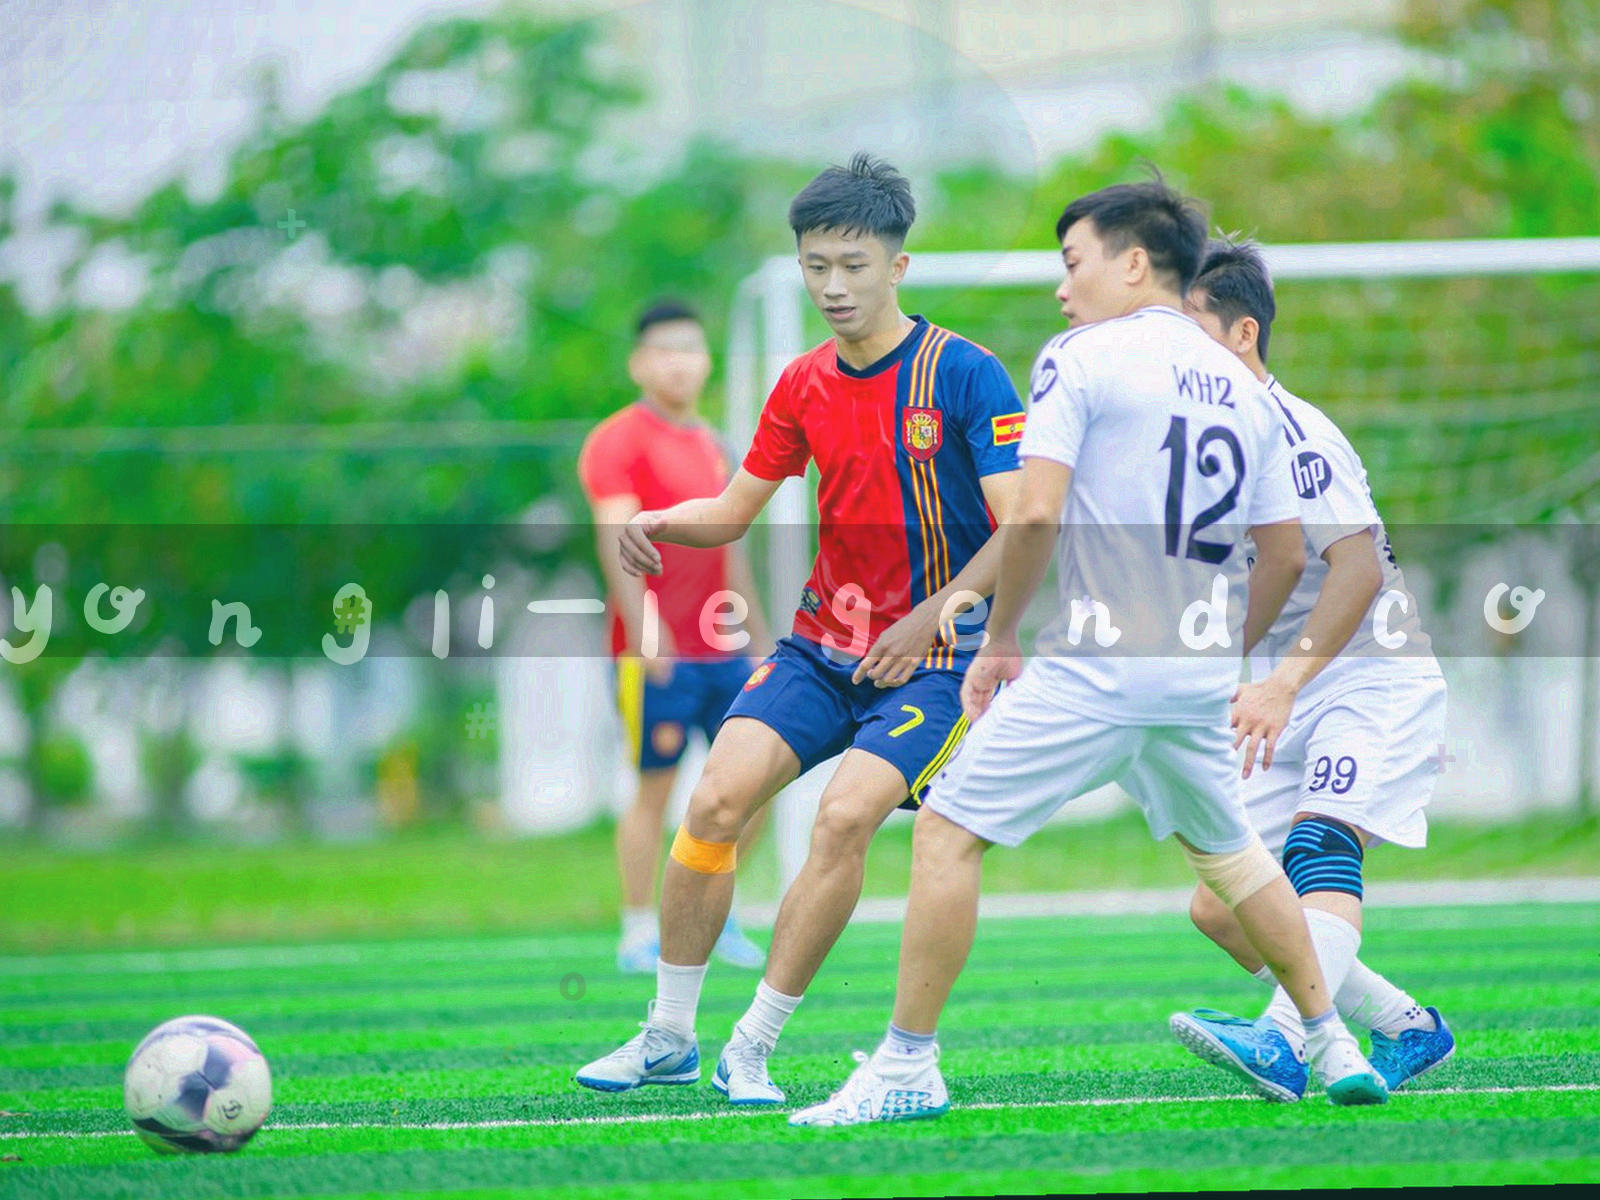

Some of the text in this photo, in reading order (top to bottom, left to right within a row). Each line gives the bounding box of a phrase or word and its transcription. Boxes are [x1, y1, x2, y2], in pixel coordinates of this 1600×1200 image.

[1172, 364, 1236, 410] WH2
[1159, 414, 1246, 565] 12
[1291, 451, 1332, 499] hp
[887, 704, 926, 738] 7
[1309, 755, 1358, 795] 99
